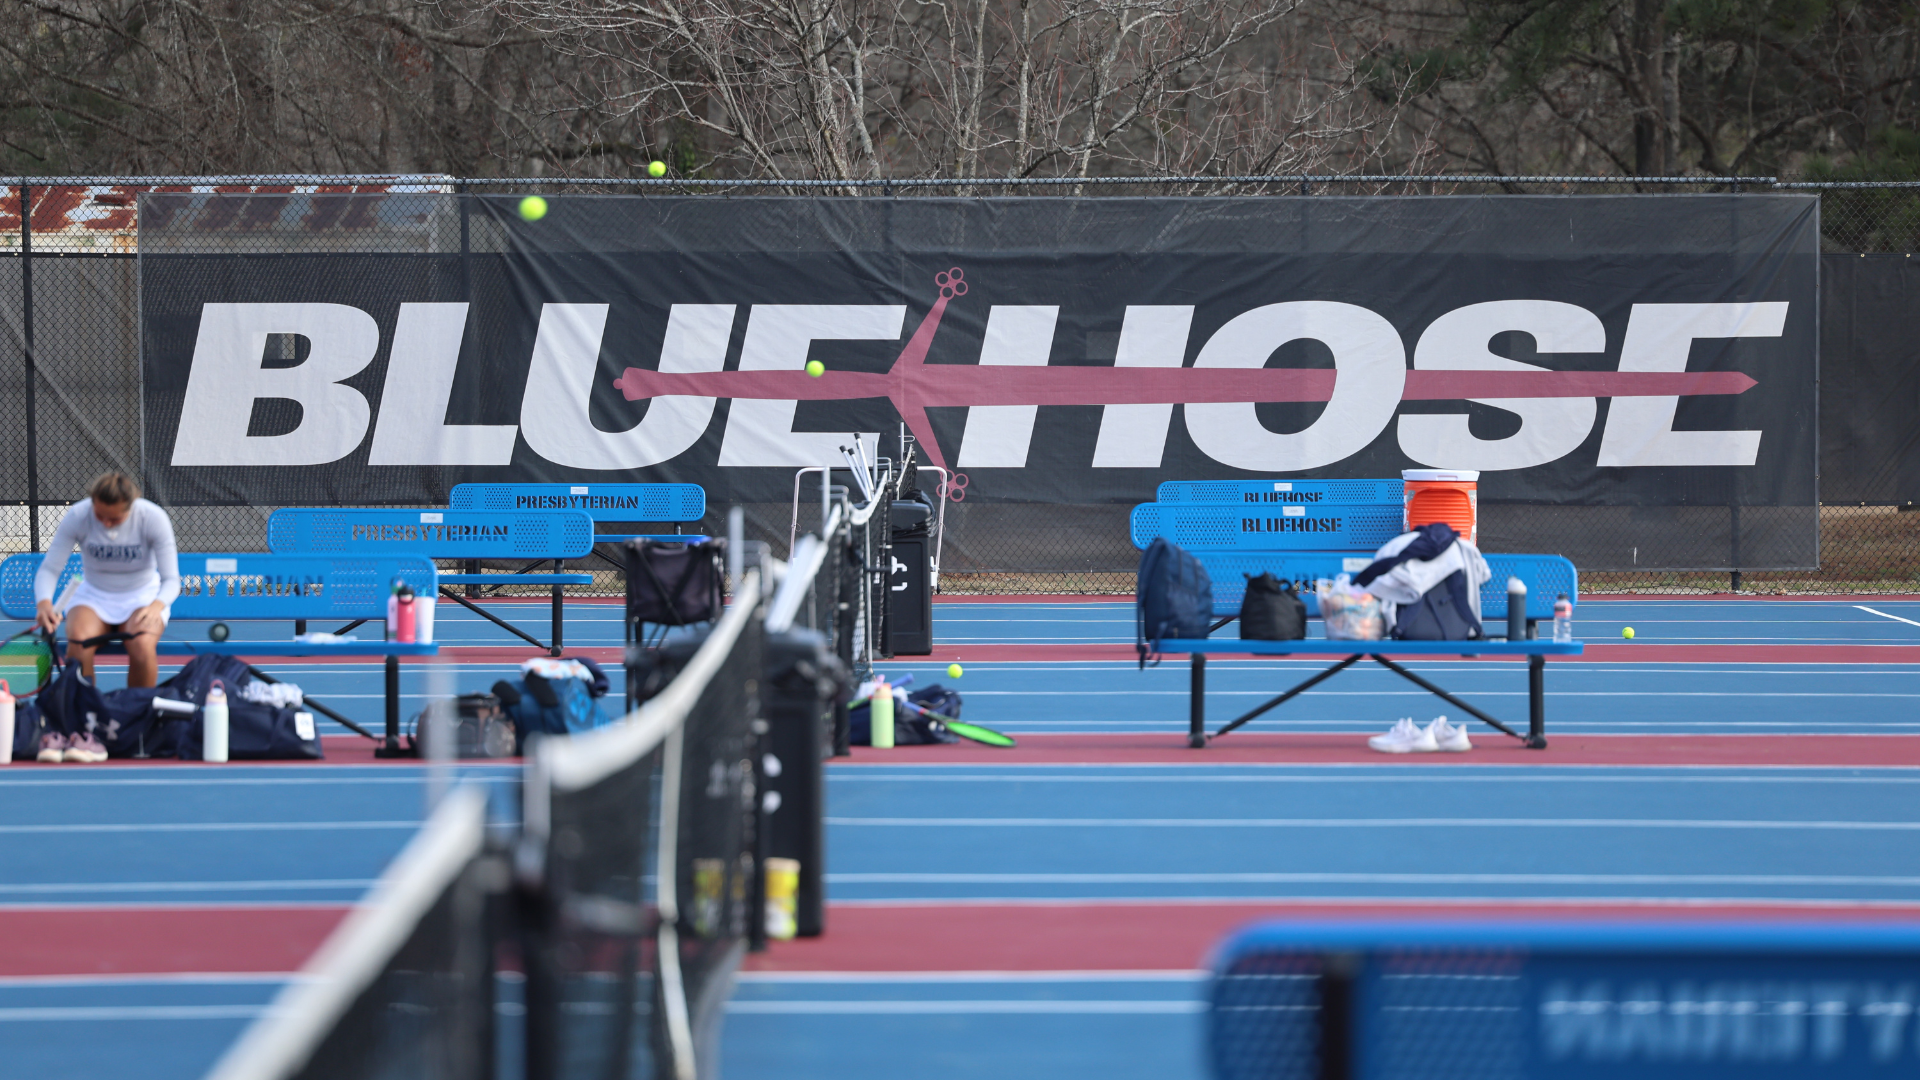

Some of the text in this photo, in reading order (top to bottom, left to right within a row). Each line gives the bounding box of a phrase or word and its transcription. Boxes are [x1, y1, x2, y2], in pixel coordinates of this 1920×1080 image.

[171, 299, 1790, 472] BLUE HOSE
[516, 495, 639, 509] PRESBYTERIAN
[1243, 492, 1323, 503] BLUEHOSE
[352, 525, 509, 541] PRESBYTERIAN
[1241, 518, 1342, 534] BLUEHOSE
[179, 575, 324, 597] BYTERIAN
